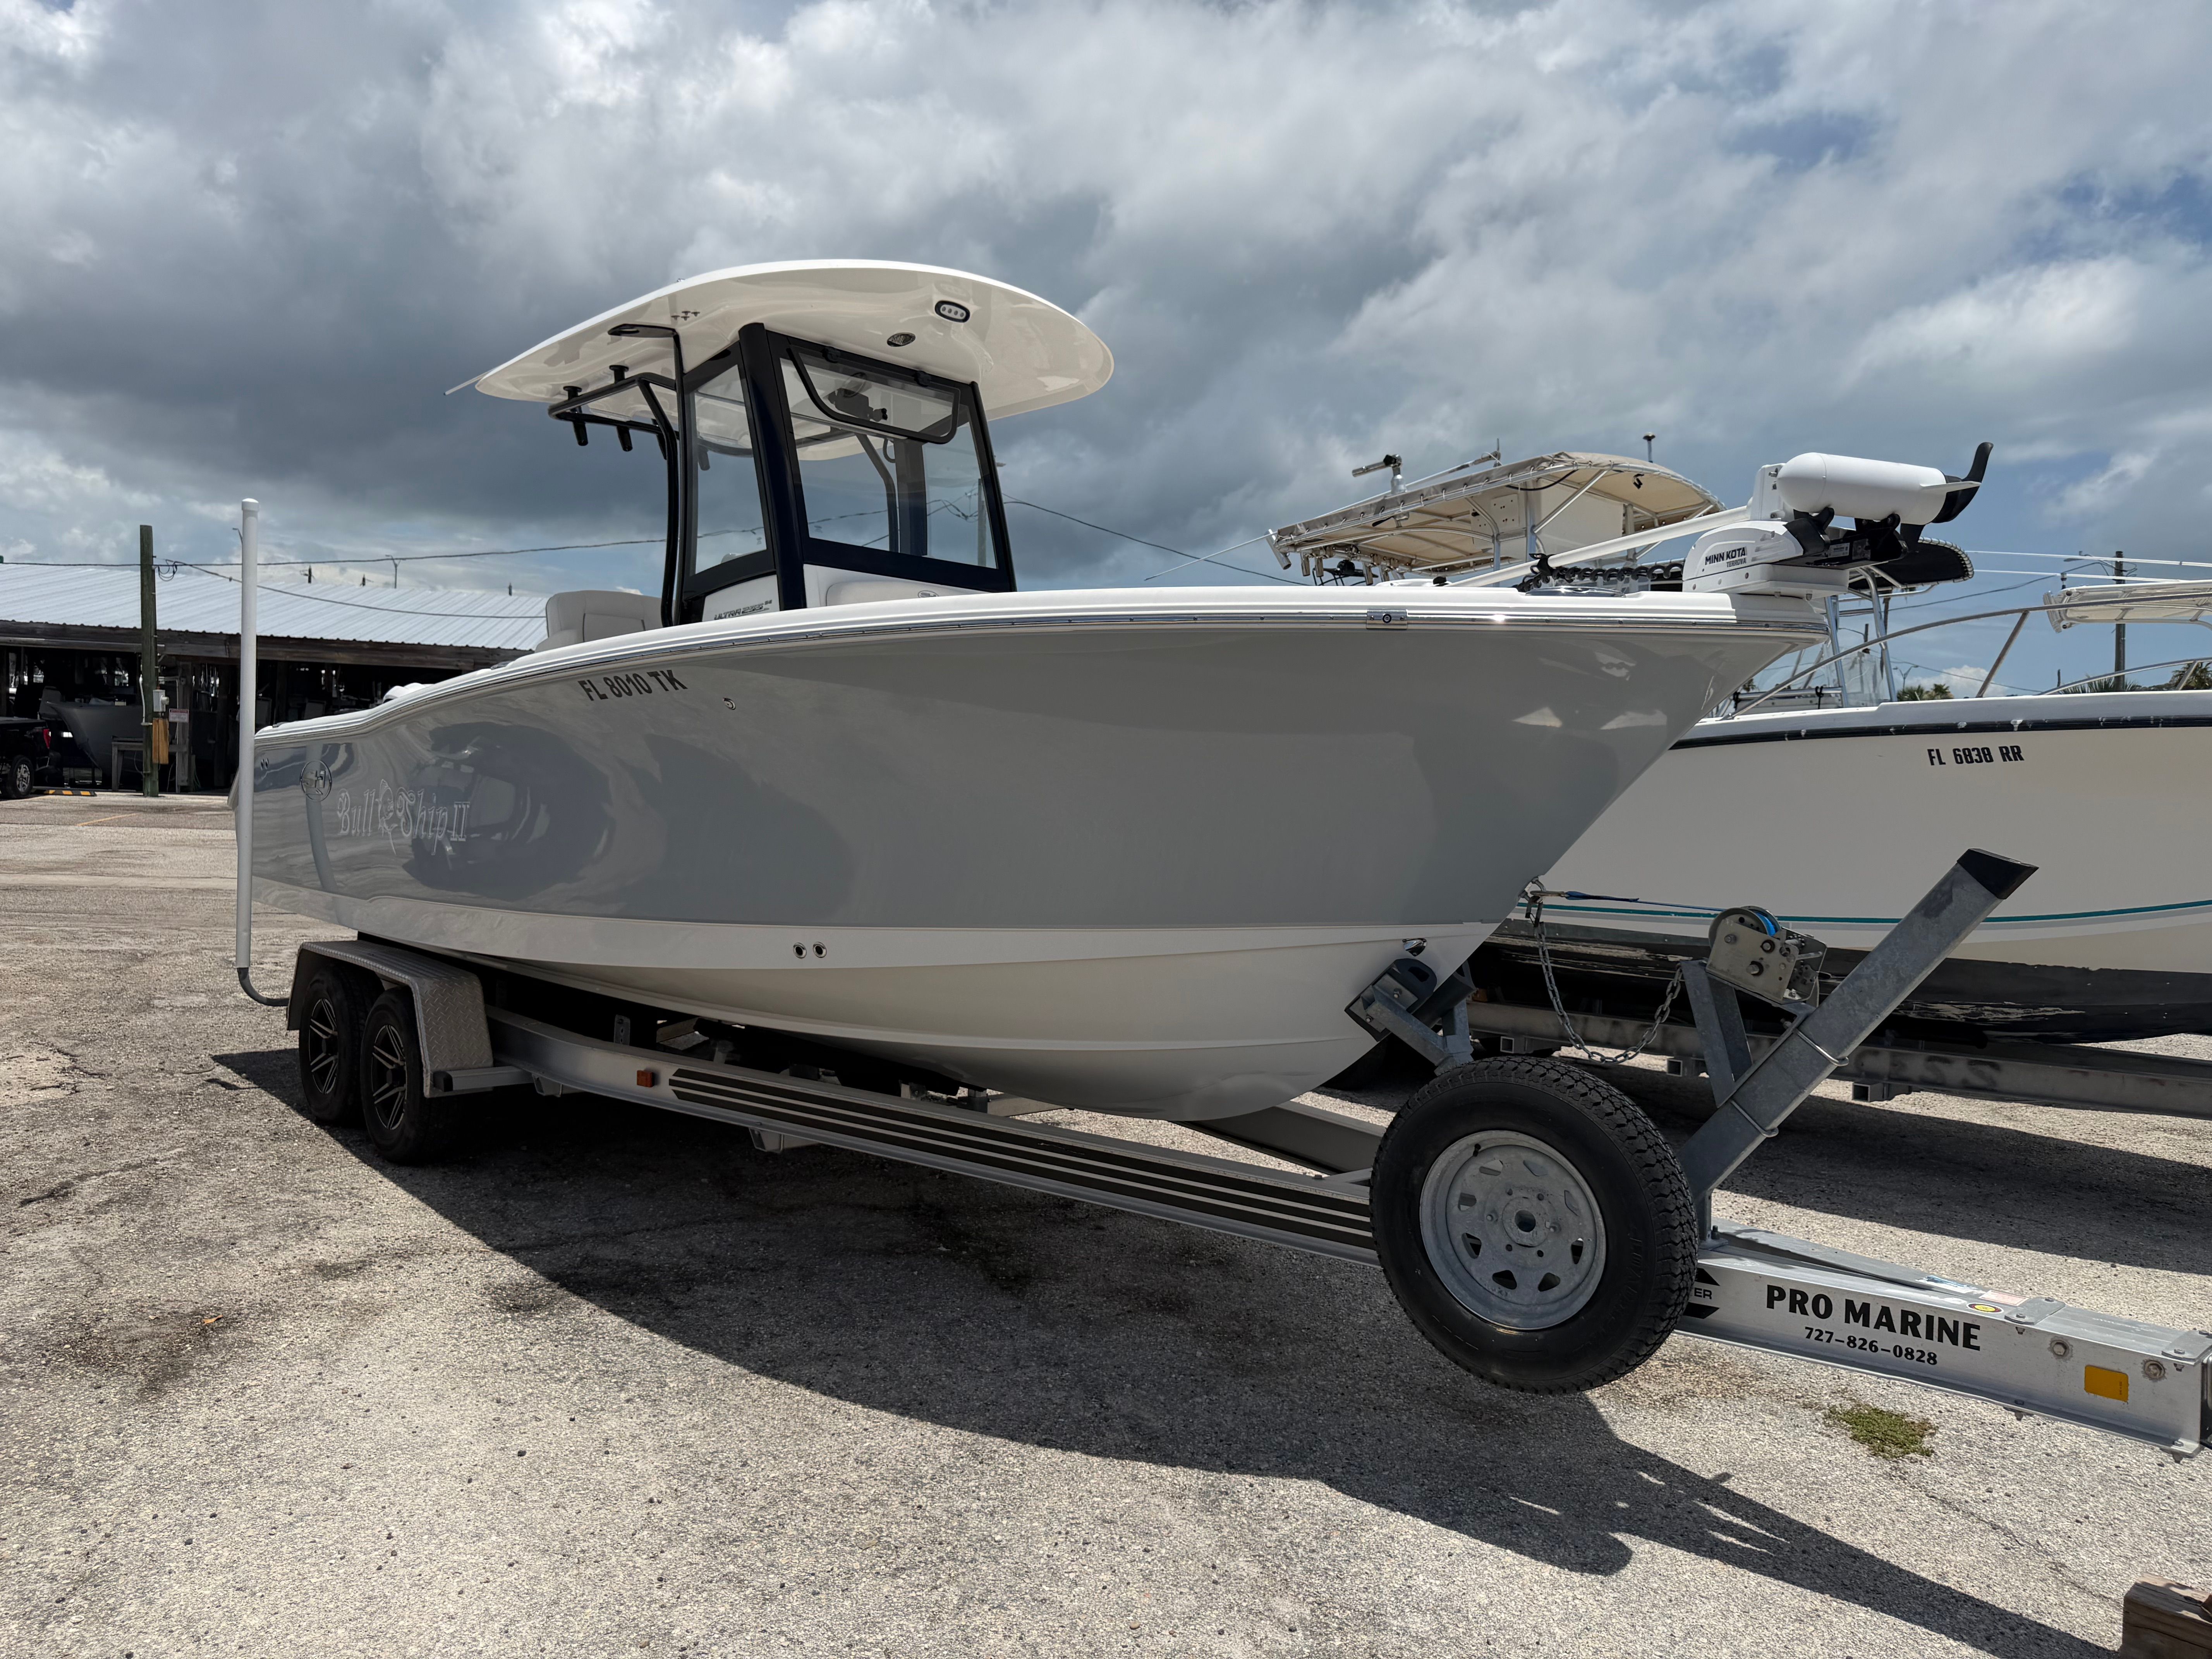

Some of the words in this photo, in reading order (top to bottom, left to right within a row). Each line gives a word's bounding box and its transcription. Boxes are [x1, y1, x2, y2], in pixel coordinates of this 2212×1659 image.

[1705, 552, 1724, 565] MINN
[1726, 547, 1745, 560] KOTA
[714, 608, 741, 620] ULTRA
[578, 680, 608, 701] FL
[603, 673, 653, 697] 8010
[647, 670, 688, 691] TK
[1927, 749, 1946, 766] FL
[1953, 747, 1994, 764] 6838
[1998, 745, 2025, 762] RR
[337, 788, 376, 836] Bull
[397, 787, 448, 855] Ship
[1767, 1285, 1832, 1319] PRO
[1844, 1299, 1980, 1351] MARINE
[1805, 1327, 1937, 1365] 727-826-0828
